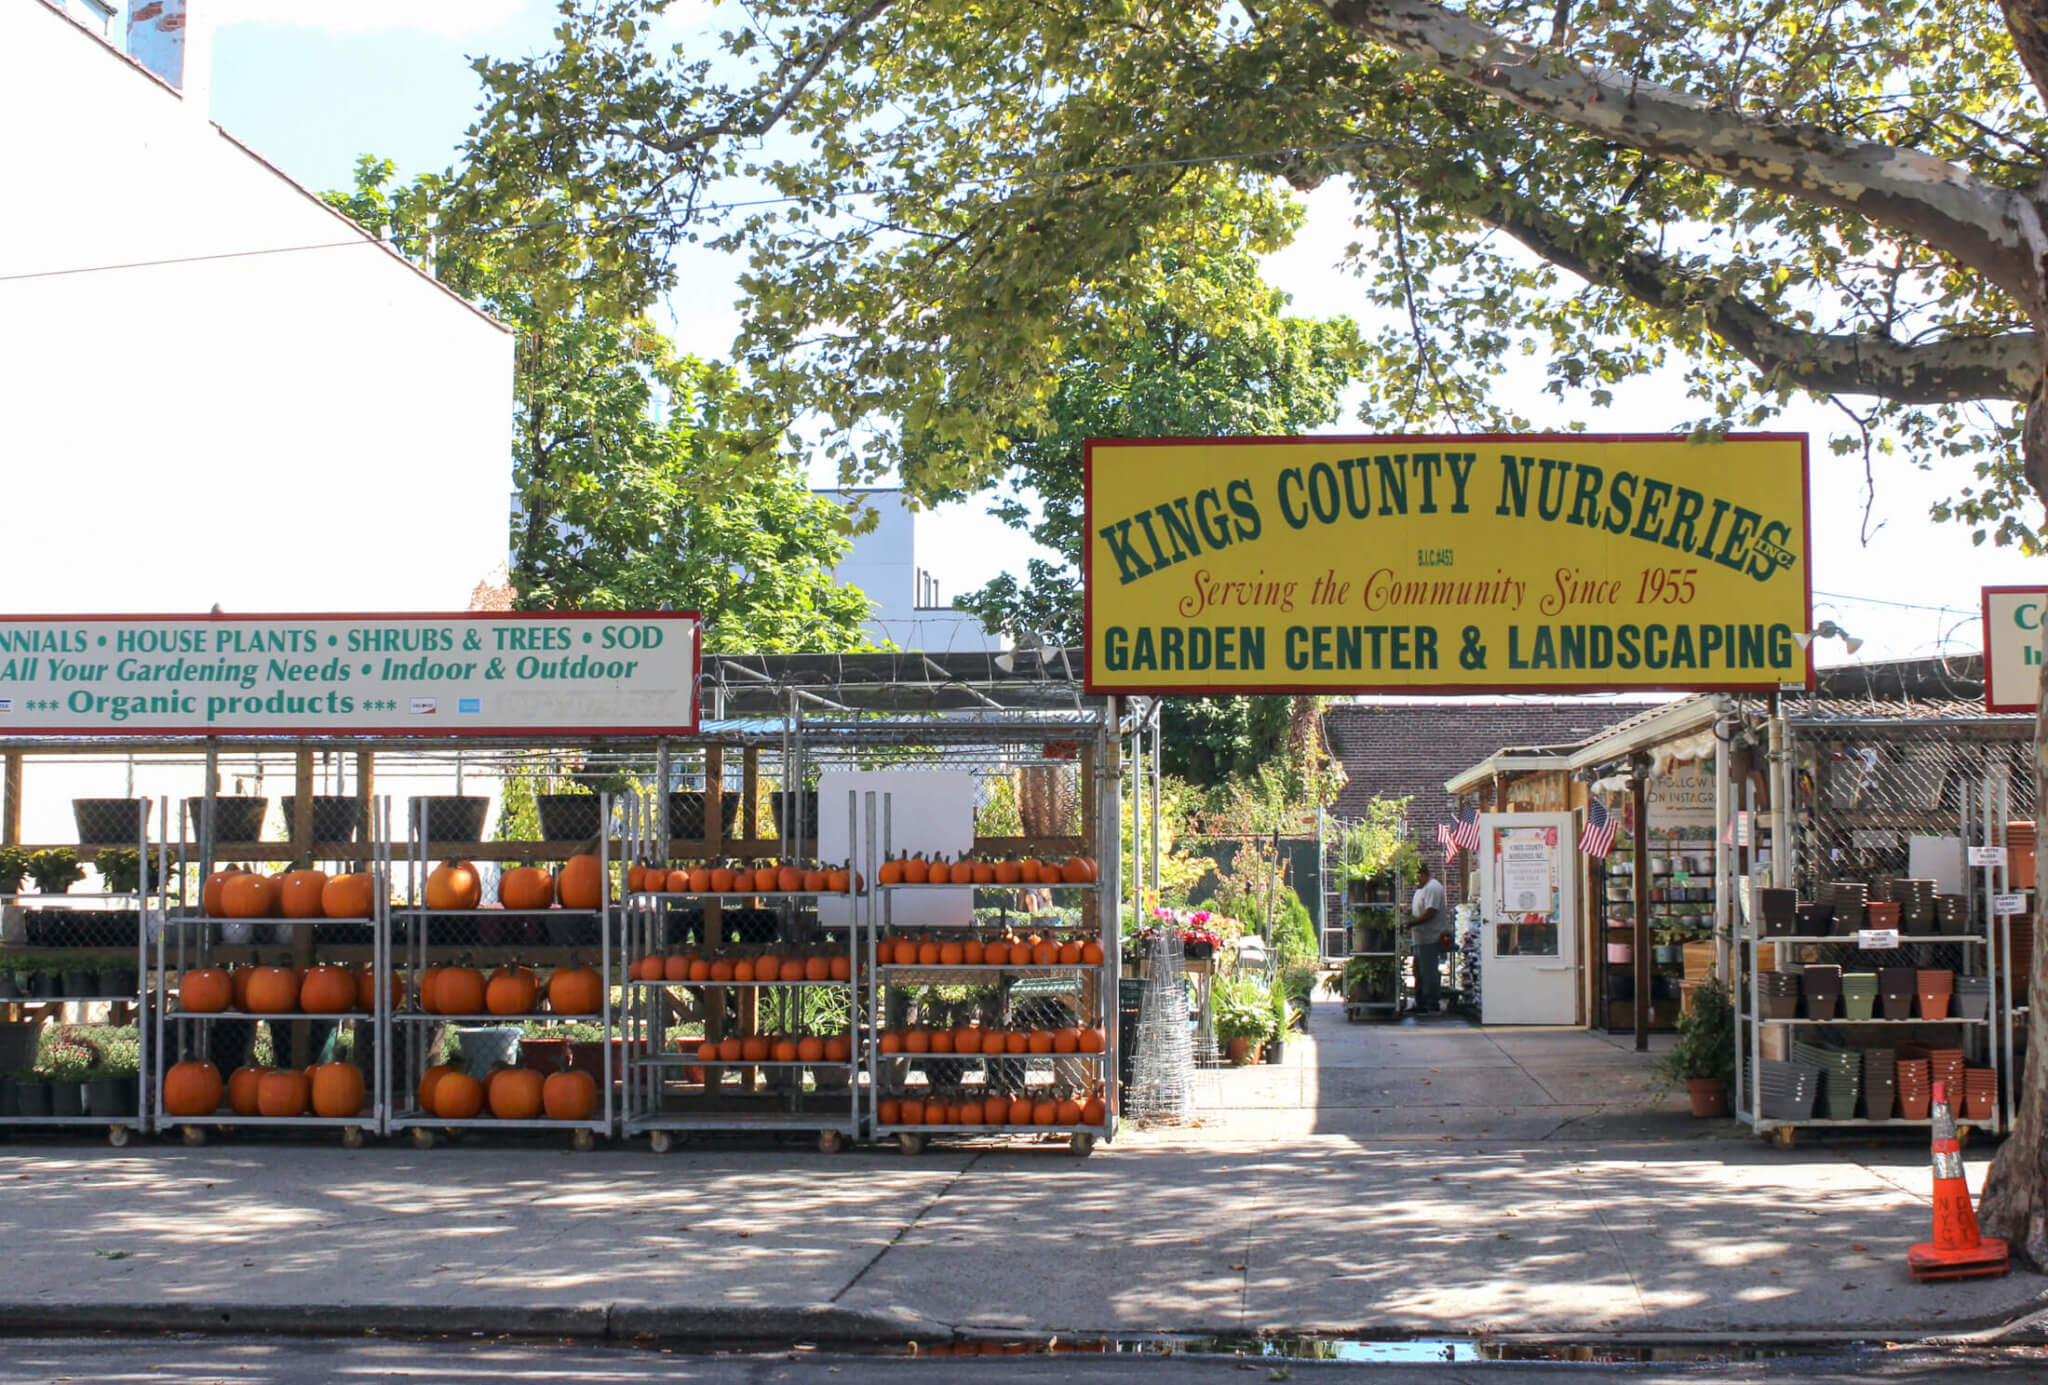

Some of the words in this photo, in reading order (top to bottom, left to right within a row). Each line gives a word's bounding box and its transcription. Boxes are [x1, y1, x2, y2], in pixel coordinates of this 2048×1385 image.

[1099, 479, 1261, 585] KINGS
[1278, 453, 1476, 529] COUNTY
[1496, 455, 1793, 584] NURSERIES
[1753, 537, 1797, 570] INC.
[1179, 570, 1296, 618] Serving
[1311, 569, 1349, 605] the
[1364, 568, 1526, 611] Community
[1540, 568, 1621, 616] Since
[1636, 568, 1697, 604] 1955
[117, 630, 206, 653] HOUSE
[216, 630, 316, 653] PLANTS
[348, 628, 452, 653] SHRUBS
[464, 629, 480, 651] &
[493, 627, 571, 650] TREES
[602, 626, 662, 648] SOD
[1105, 627, 1265, 671] GARDEN
[1286, 626, 1438, 670] CENTER
[1460, 626, 1487, 670] &
[1509, 624, 1792, 669] LANDSCAPING
[0, 657, 37, 681] All
[48, 659, 109, 681] Your
[116, 658, 258, 690] Gardening
[268, 658, 350, 682] Needs
[382, 656, 475, 680] Indoor
[485, 659, 504, 680] &
[516, 656, 637, 680] Outdoor
[68, 689, 195, 720] Organic
[208, 687, 353, 722] products
